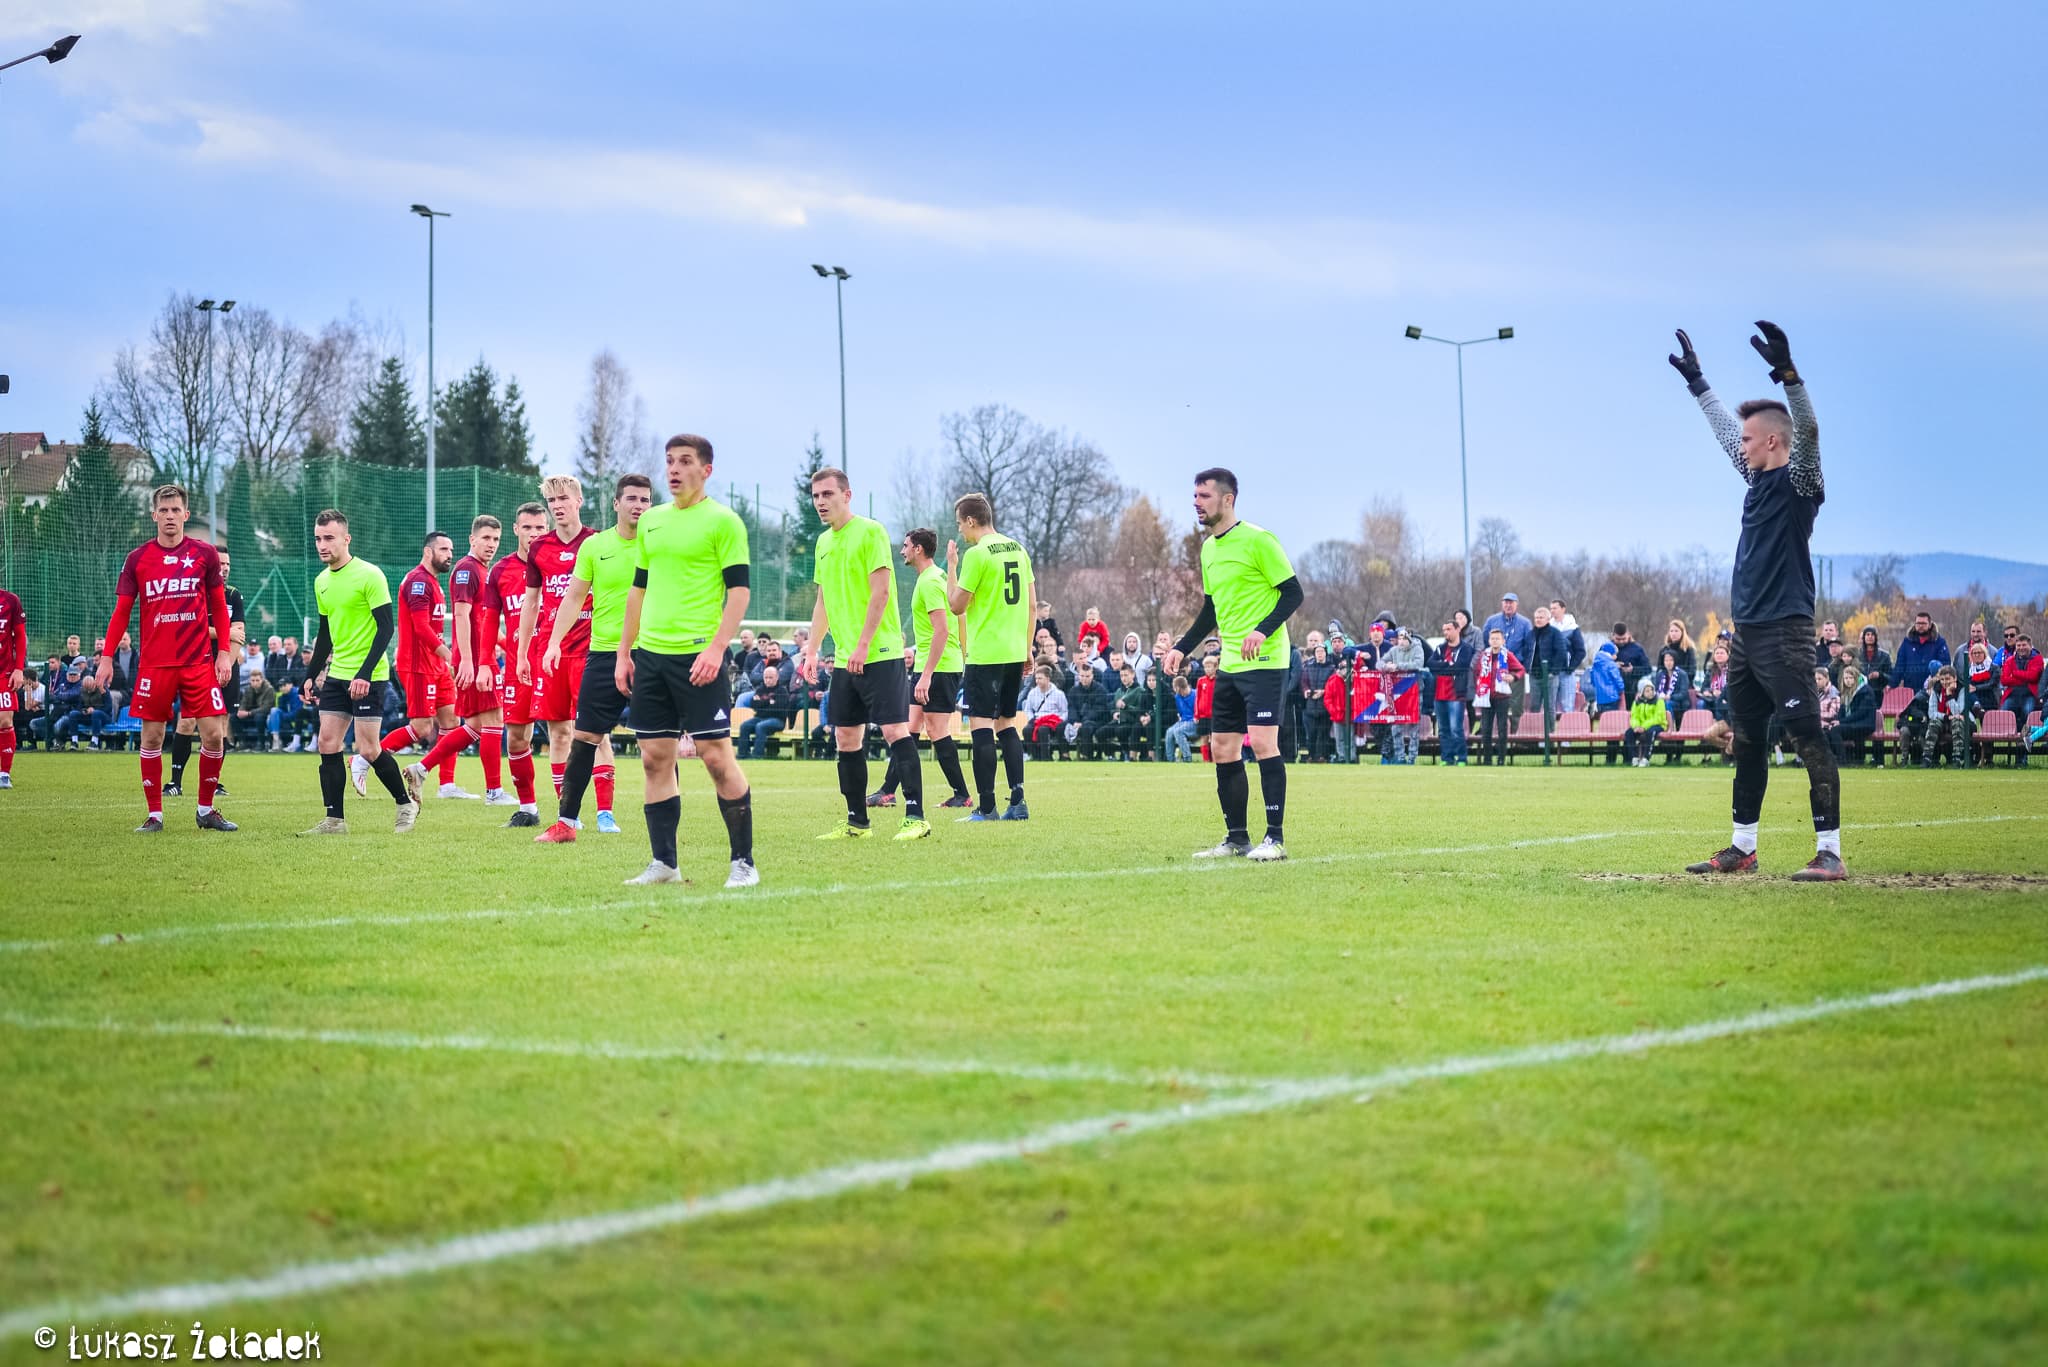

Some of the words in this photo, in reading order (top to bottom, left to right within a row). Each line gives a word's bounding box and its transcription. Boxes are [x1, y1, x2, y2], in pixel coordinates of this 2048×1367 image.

[146, 578, 200, 596] LVBET
[1004, 561, 1020, 605] 5
[211, 687, 223, 710] 8
